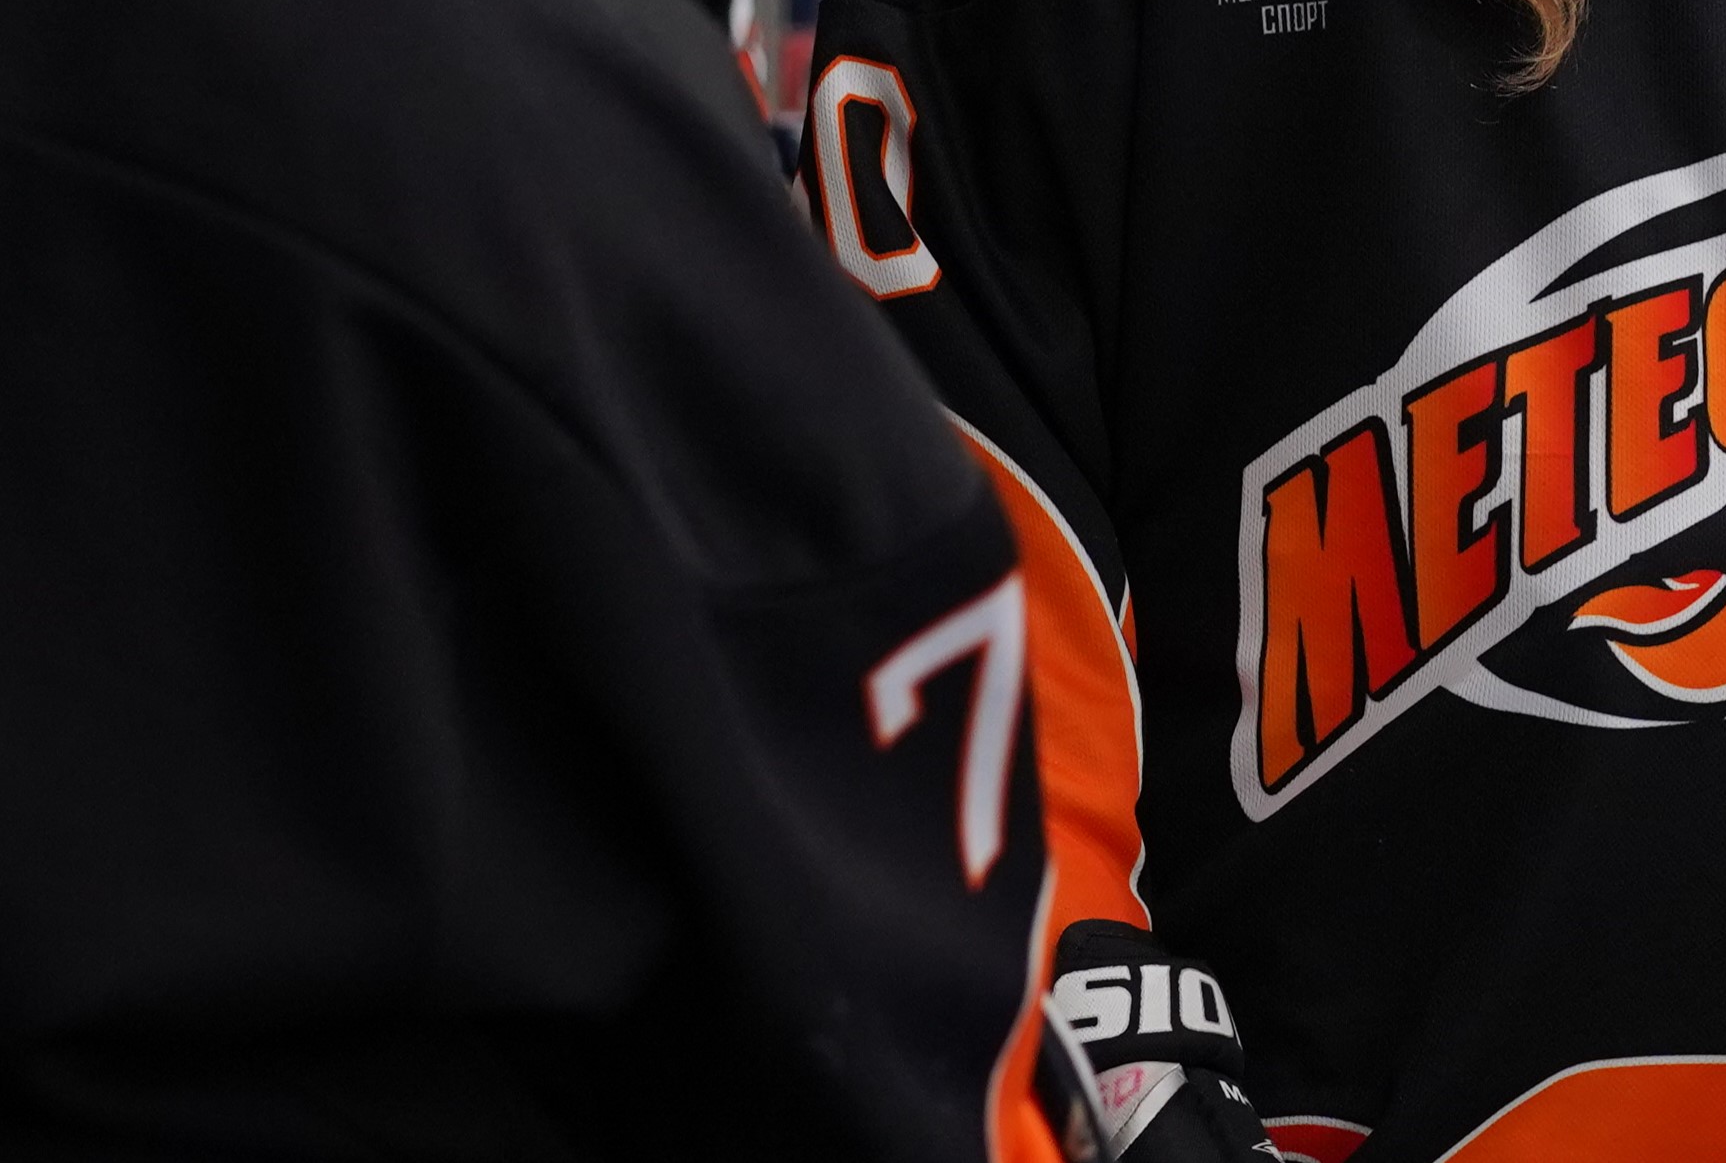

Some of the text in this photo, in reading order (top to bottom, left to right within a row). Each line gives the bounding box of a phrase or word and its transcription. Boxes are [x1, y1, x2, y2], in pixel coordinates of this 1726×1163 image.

[1260, 0, 1329, 35] СПОРТ
[860, 570, 1027, 894] 7
[1053, 963, 1243, 1050] SIO
